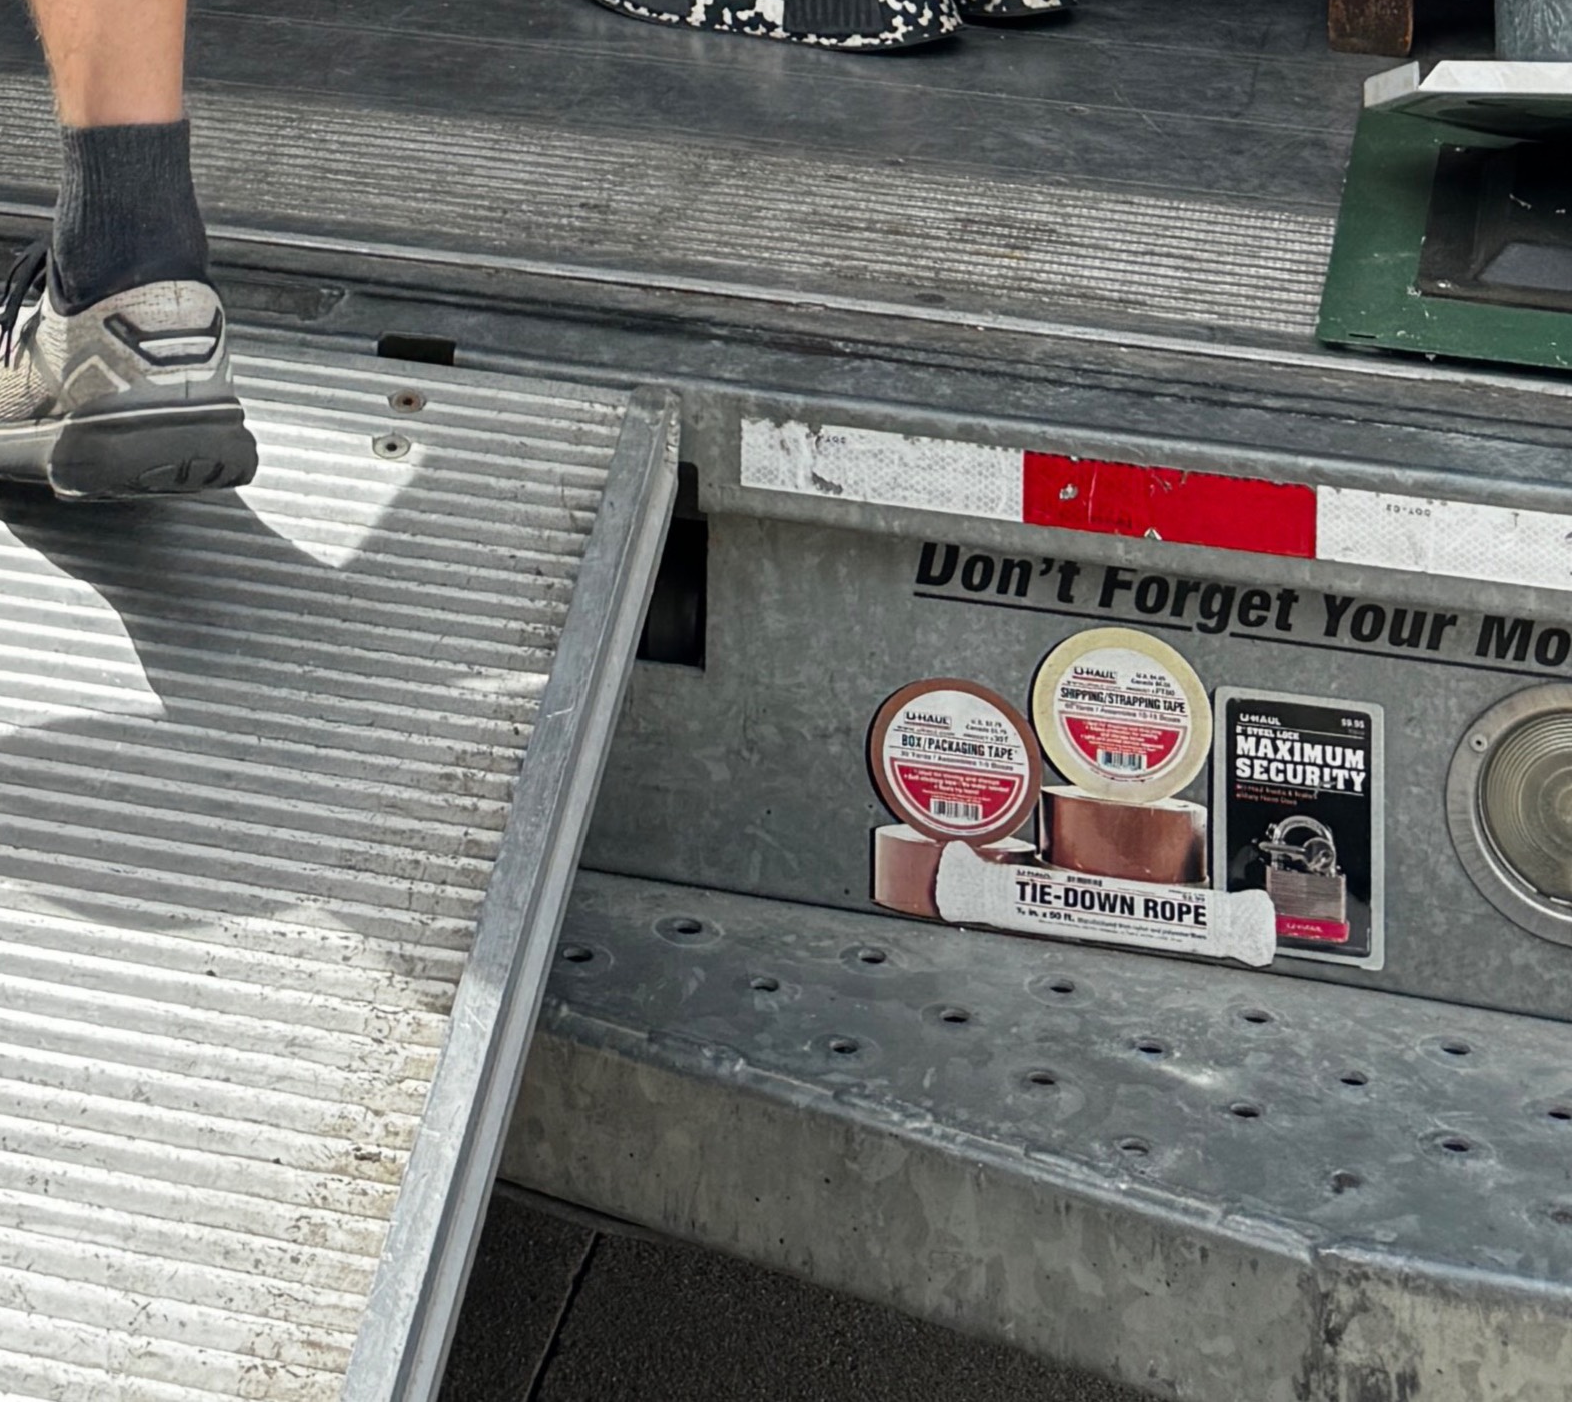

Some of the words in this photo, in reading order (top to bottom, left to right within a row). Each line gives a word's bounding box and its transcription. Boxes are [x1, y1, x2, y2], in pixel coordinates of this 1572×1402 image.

[915, 543, 1082, 604] Don't
[1099, 566, 1293, 634] Forget
[1322, 593, 1456, 650] Your
[1477, 615, 1572, 666] Mo
[1060, 687, 1161, 712] SHIPPING/STRAPPING
[1163, 700, 1185, 714] TAPE
[1239, 713, 1281, 726] U-HAUL
[1247, 727, 1275, 738] STEEL
[1276, 731, 1300, 741] LOCK
[988, 745, 1013, 761] TAPE
[1235, 735, 1365, 770] MAXIMUM
[1235, 757, 1366, 792] SECURITY
[1015, 881, 1135, 916] TIE-DOWN
[1143, 898, 1207, 926] ROPE
[1049, 911, 1062, 921] 50
